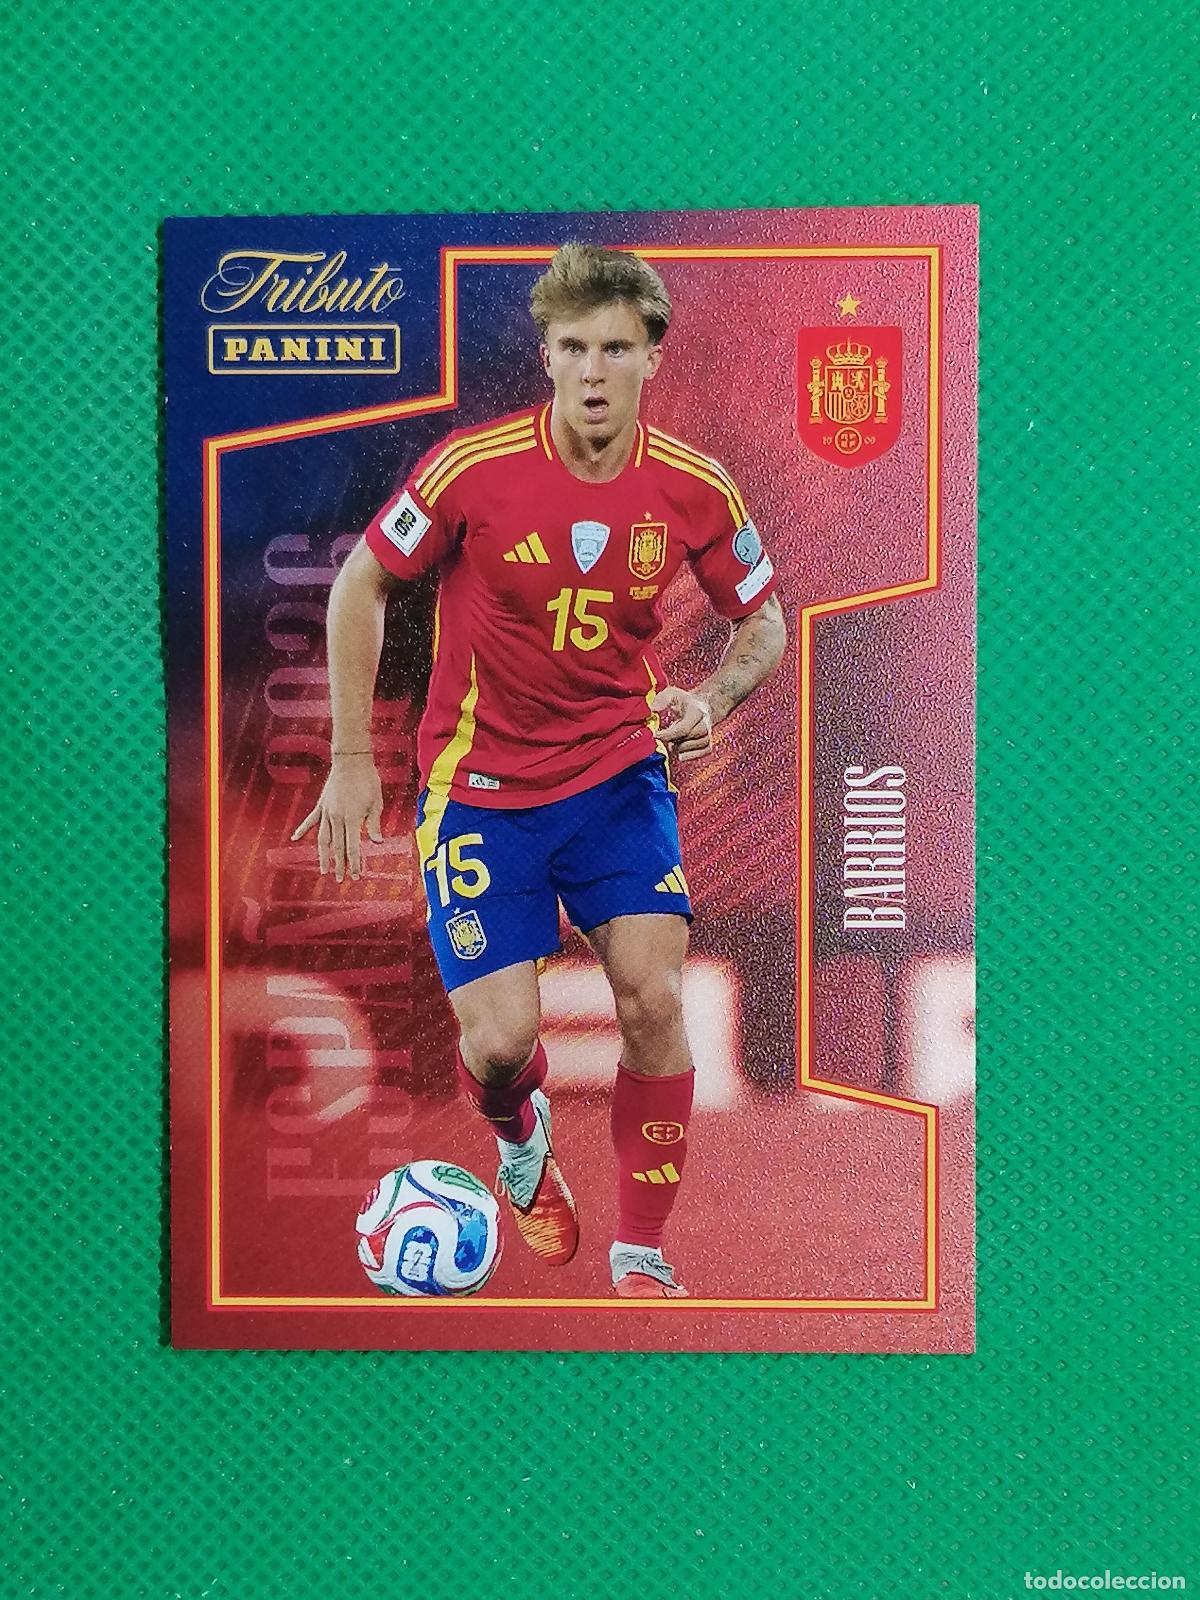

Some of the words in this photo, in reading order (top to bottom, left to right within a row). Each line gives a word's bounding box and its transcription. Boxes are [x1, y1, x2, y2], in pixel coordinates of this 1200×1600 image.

[201, 250, 406, 314] Tributo
[223, 336, 386, 362] PANINI
[547, 587, 613, 651] 15
[426, 832, 491, 907] 15
[843, 765, 906, 931] BARRIOS
